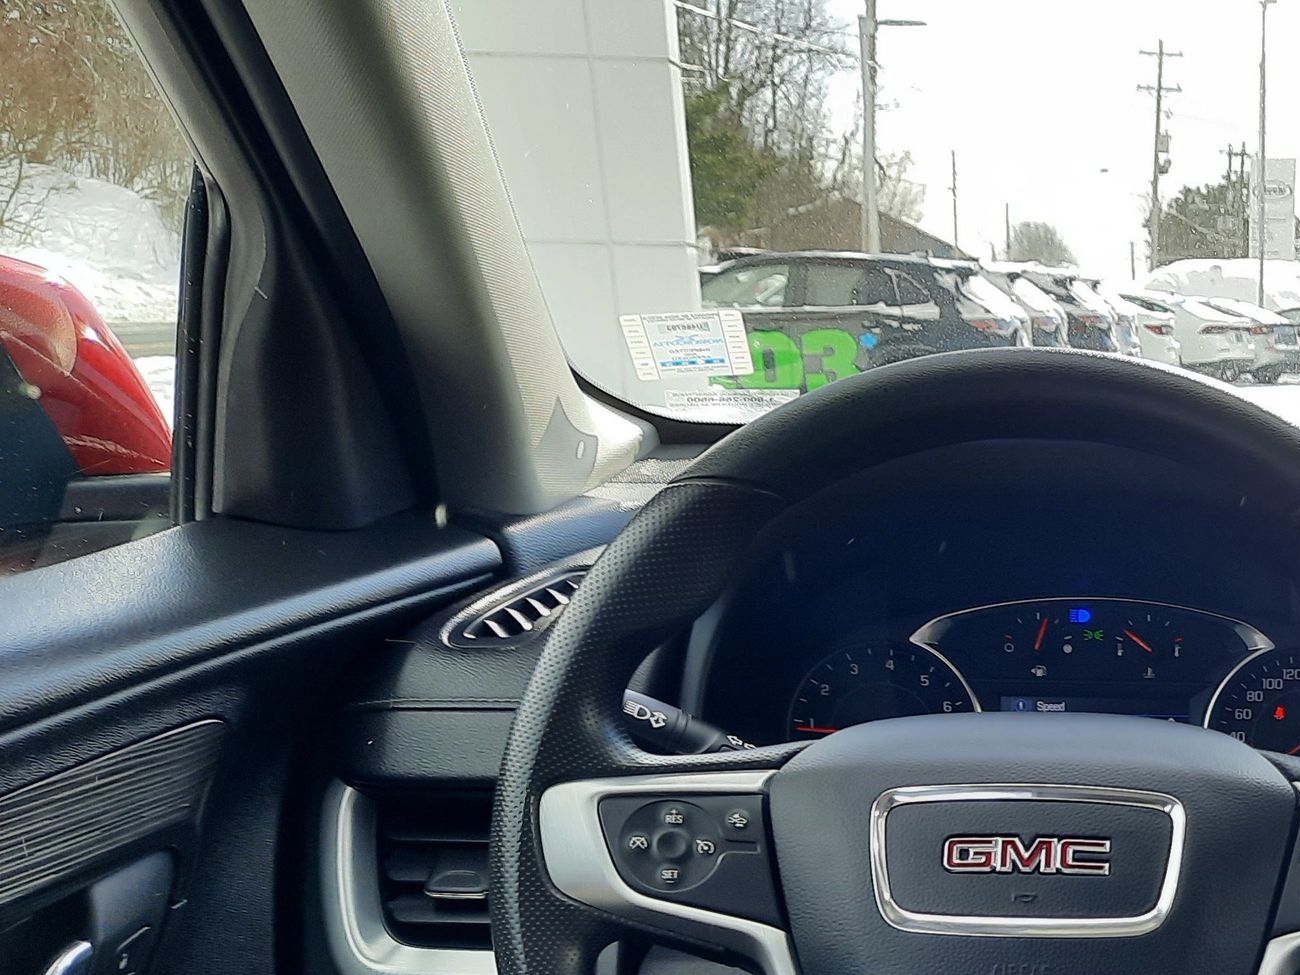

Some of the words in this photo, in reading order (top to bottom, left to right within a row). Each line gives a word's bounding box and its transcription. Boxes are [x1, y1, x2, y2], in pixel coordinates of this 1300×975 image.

[850, 663, 859, 675] 3
[886, 659, 895, 671] 4
[920, 675, 929, 687] 5
[1262, 678, 1283, 690] 100
[820, 684, 830, 696] 2
[1246, 690, 1264, 702] 80
[943, 701, 952, 712] 6
[1036, 701, 1066, 712] Speed
[1234, 708, 1252, 720] 60
[664, 814, 684, 824] RES
[943, 836, 1111, 875] GMC
[661, 870, 679, 879] SET
